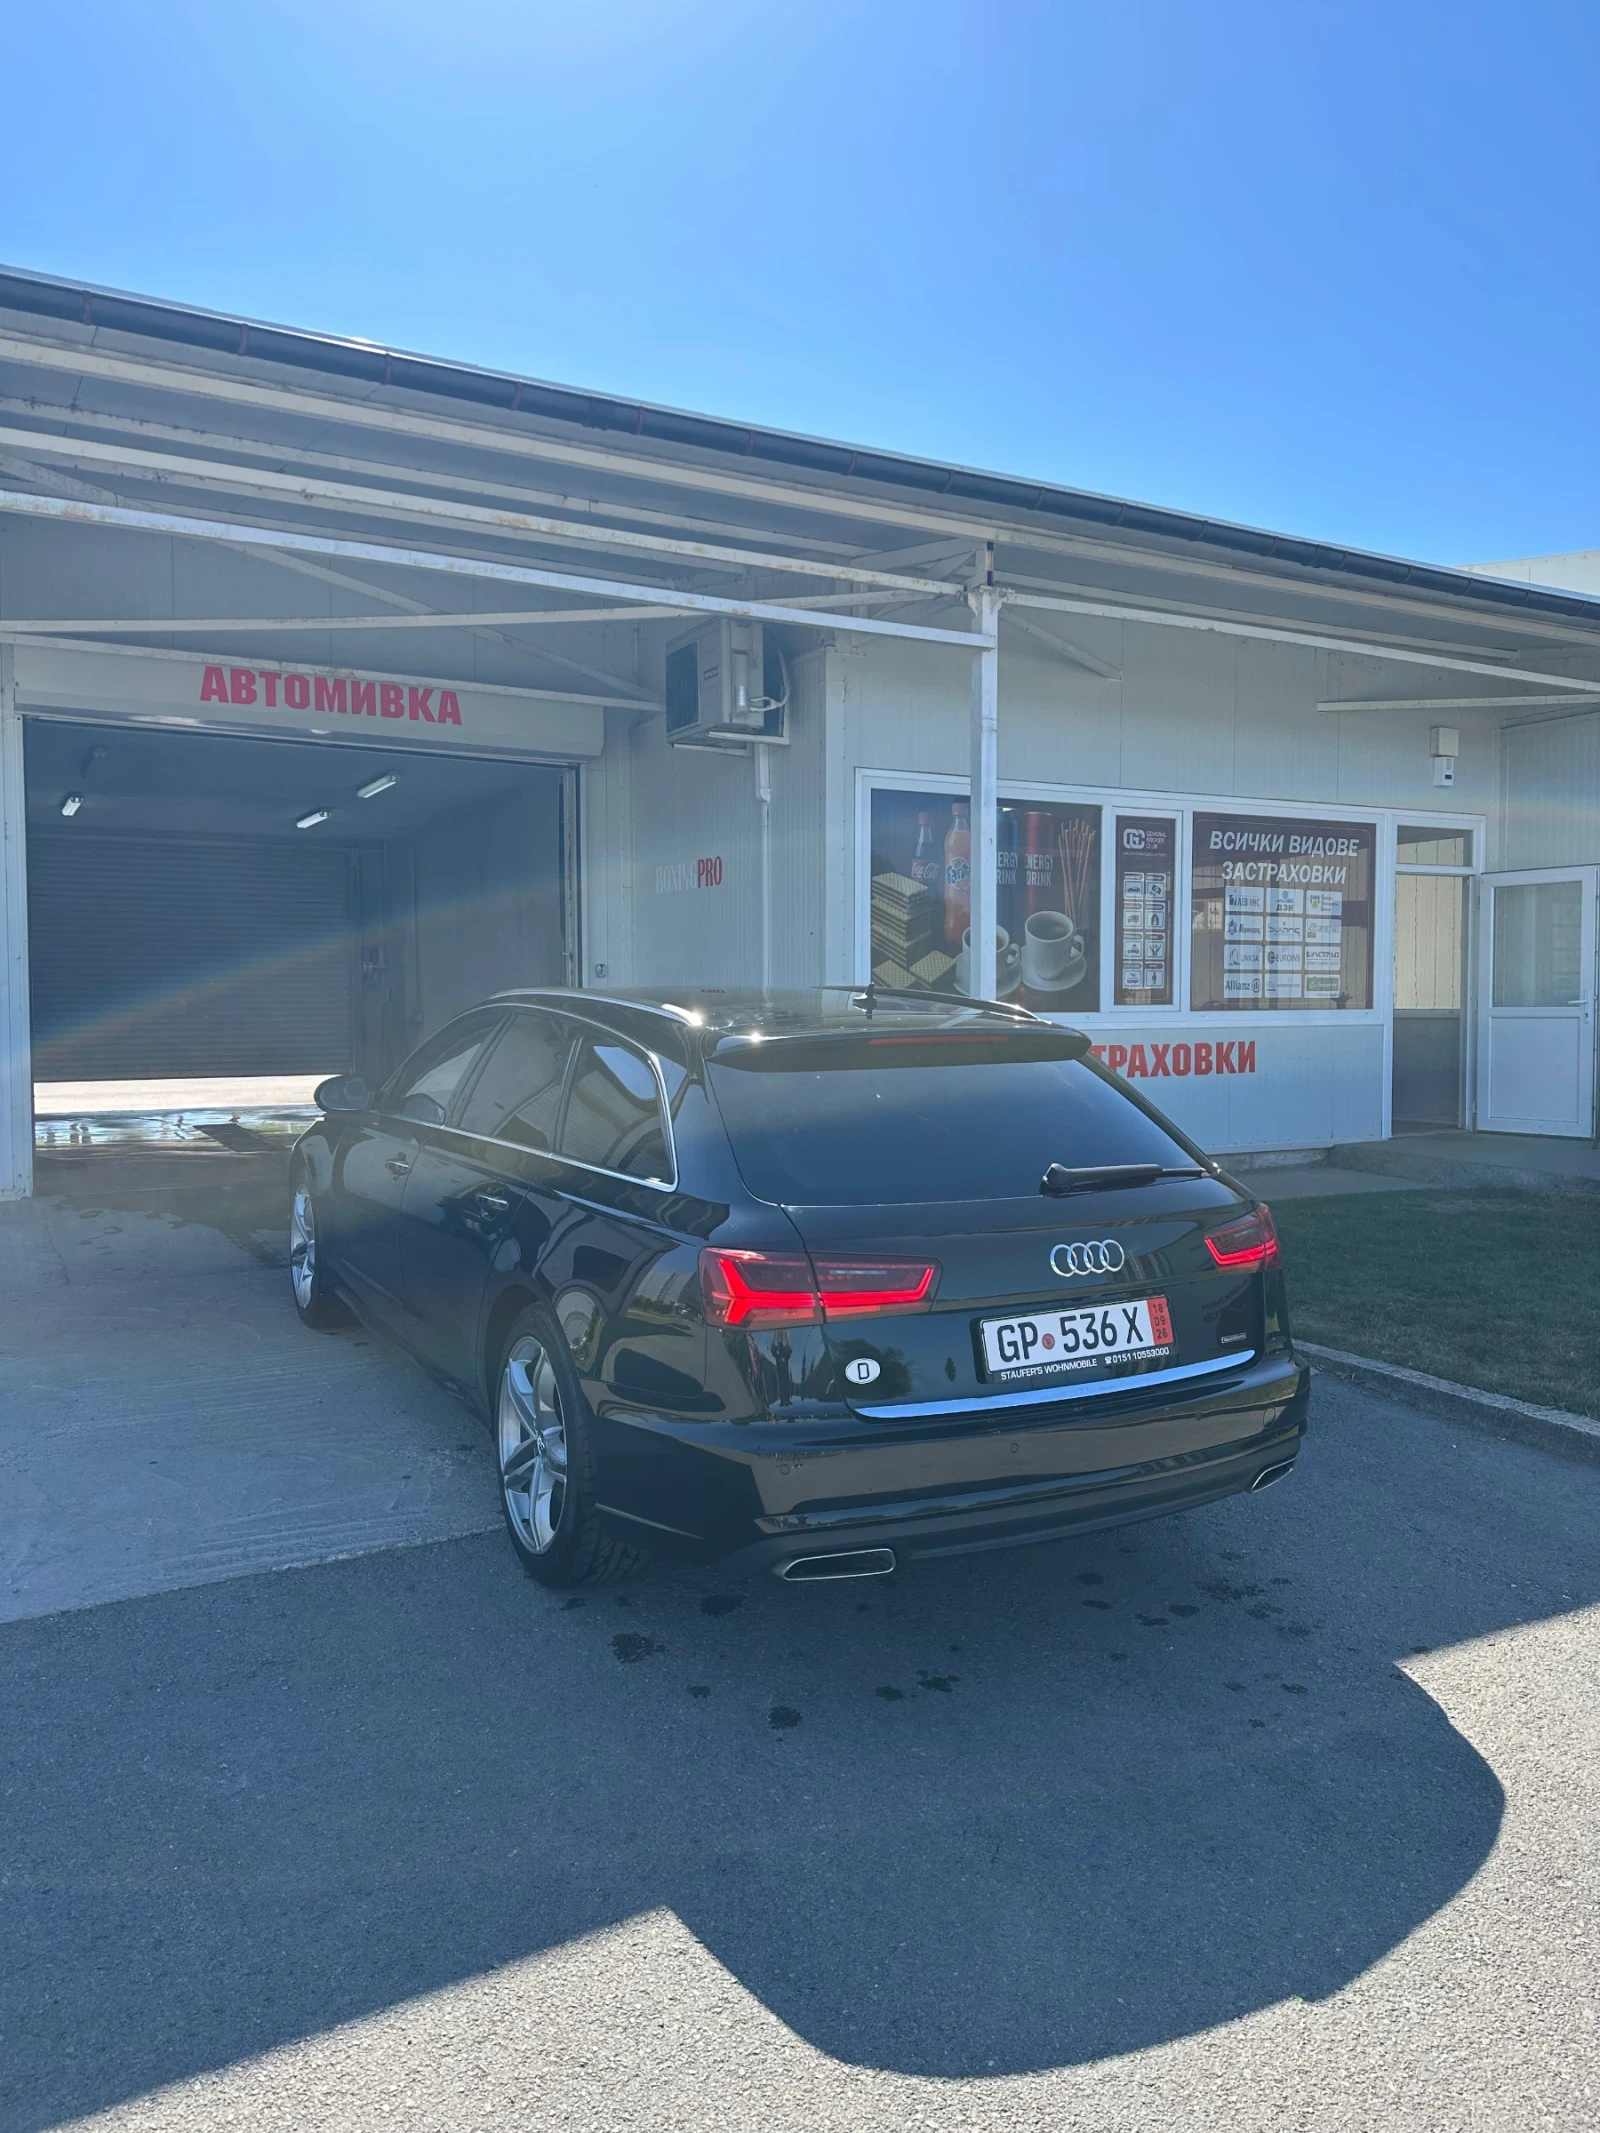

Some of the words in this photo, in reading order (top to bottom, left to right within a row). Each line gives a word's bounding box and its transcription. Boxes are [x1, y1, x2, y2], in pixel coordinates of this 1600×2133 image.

[200, 666, 462, 726] АВТОМИВКА
[1209, 830, 1285, 853] ВСИЧКИ
[1288, 835, 1360, 858] ВИДОВЕ
[997, 851, 1019, 869] ERGY
[1025, 853, 1055, 870] ENERGY
[996, 868, 1017, 885] RINK
[1026, 870, 1052, 887] DRINK
[1221, 861, 1347, 885] ЗАСТРАХОВКИ
[1225, 980, 1250, 990] Allianz
[1152, 1303, 1164, 1314] 18
[1154, 1316, 1166, 1326] 09
[996, 1322, 1038, 1364] GP
[1059, 1310, 1118, 1354] 536
[1121, 1306, 1144, 1344] X
[1156, 1328, 1168, 1339] 26
[857, 1362, 870, 1380] D
[1001, 1365, 1043, 1380] STAUFER'S
[1045, 1358, 1098, 1374] WOHNMOBILE
